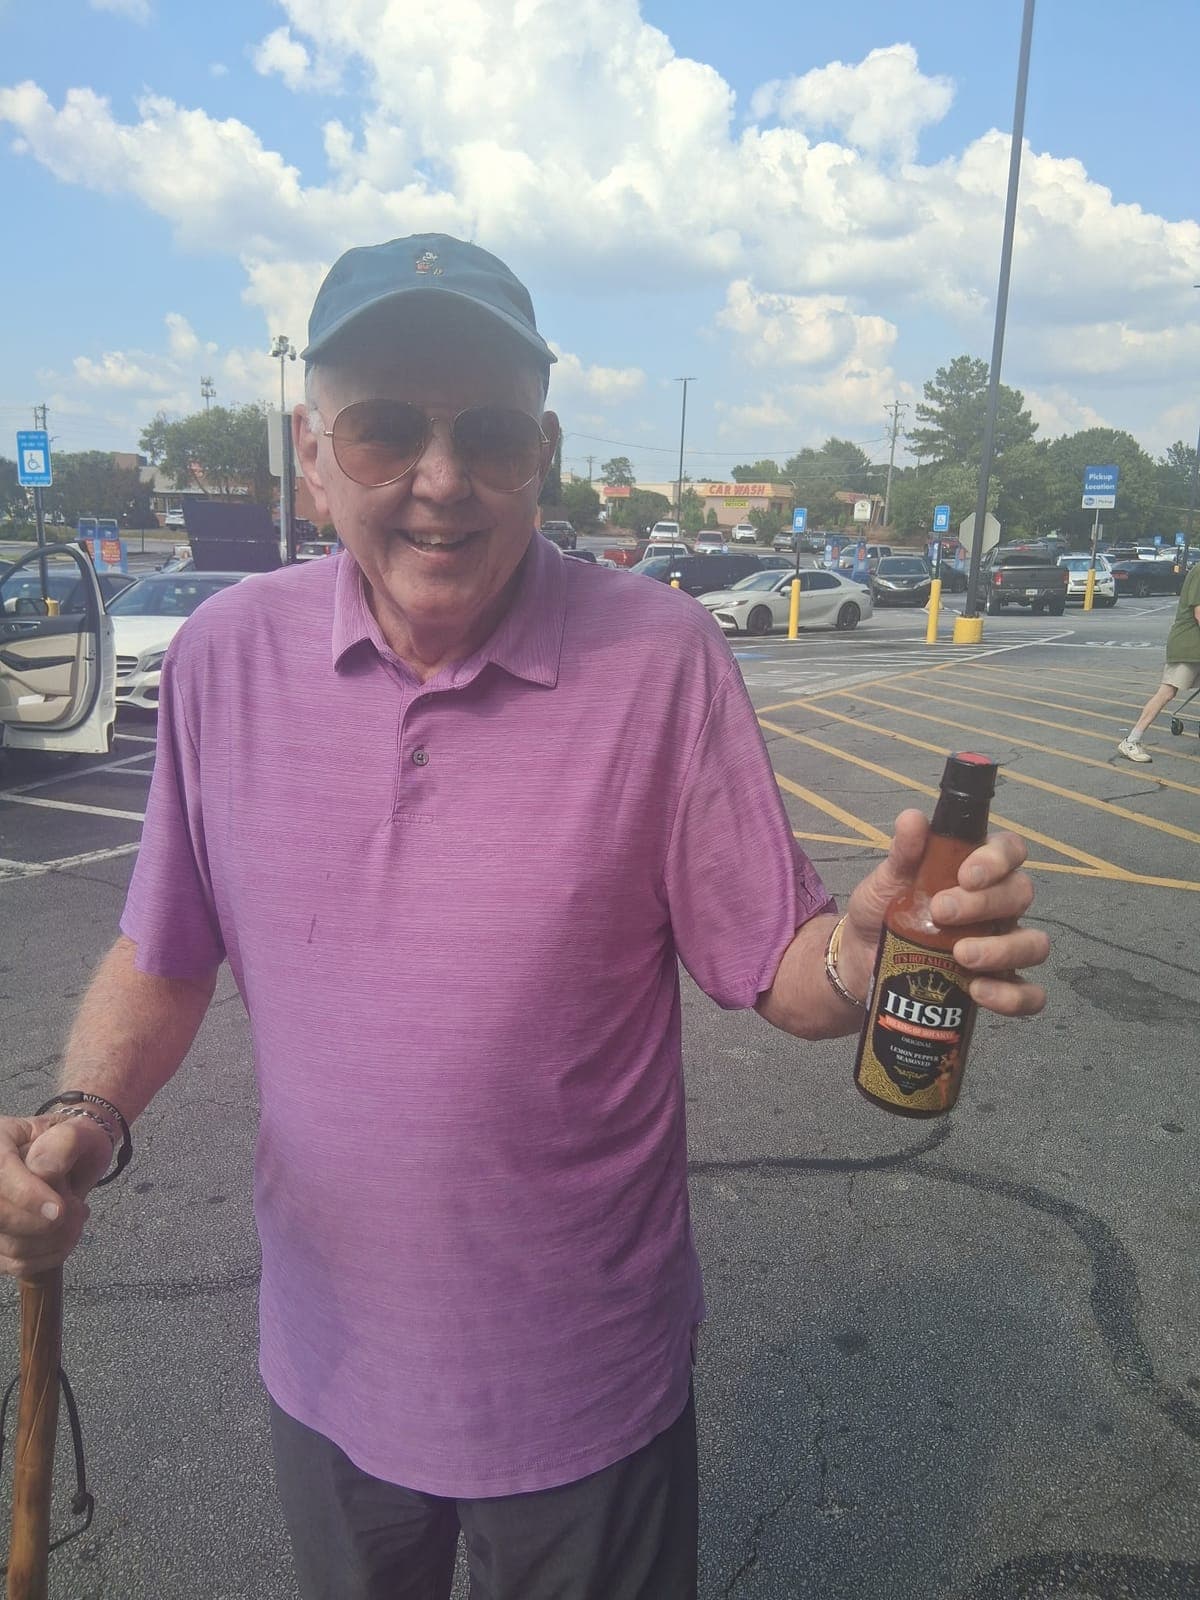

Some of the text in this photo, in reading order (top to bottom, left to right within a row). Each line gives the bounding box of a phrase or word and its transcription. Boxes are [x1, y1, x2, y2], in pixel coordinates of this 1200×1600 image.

[1089, 472, 1113, 481] Pickup
[709, 484, 766, 495] CAR WASH
[1085, 482, 1115, 490] Location
[884, 990, 962, 1028] IHSB
[890, 1044, 939, 1062] LEMON PEPPER
[896, 1054, 931, 1067] SEASONED
